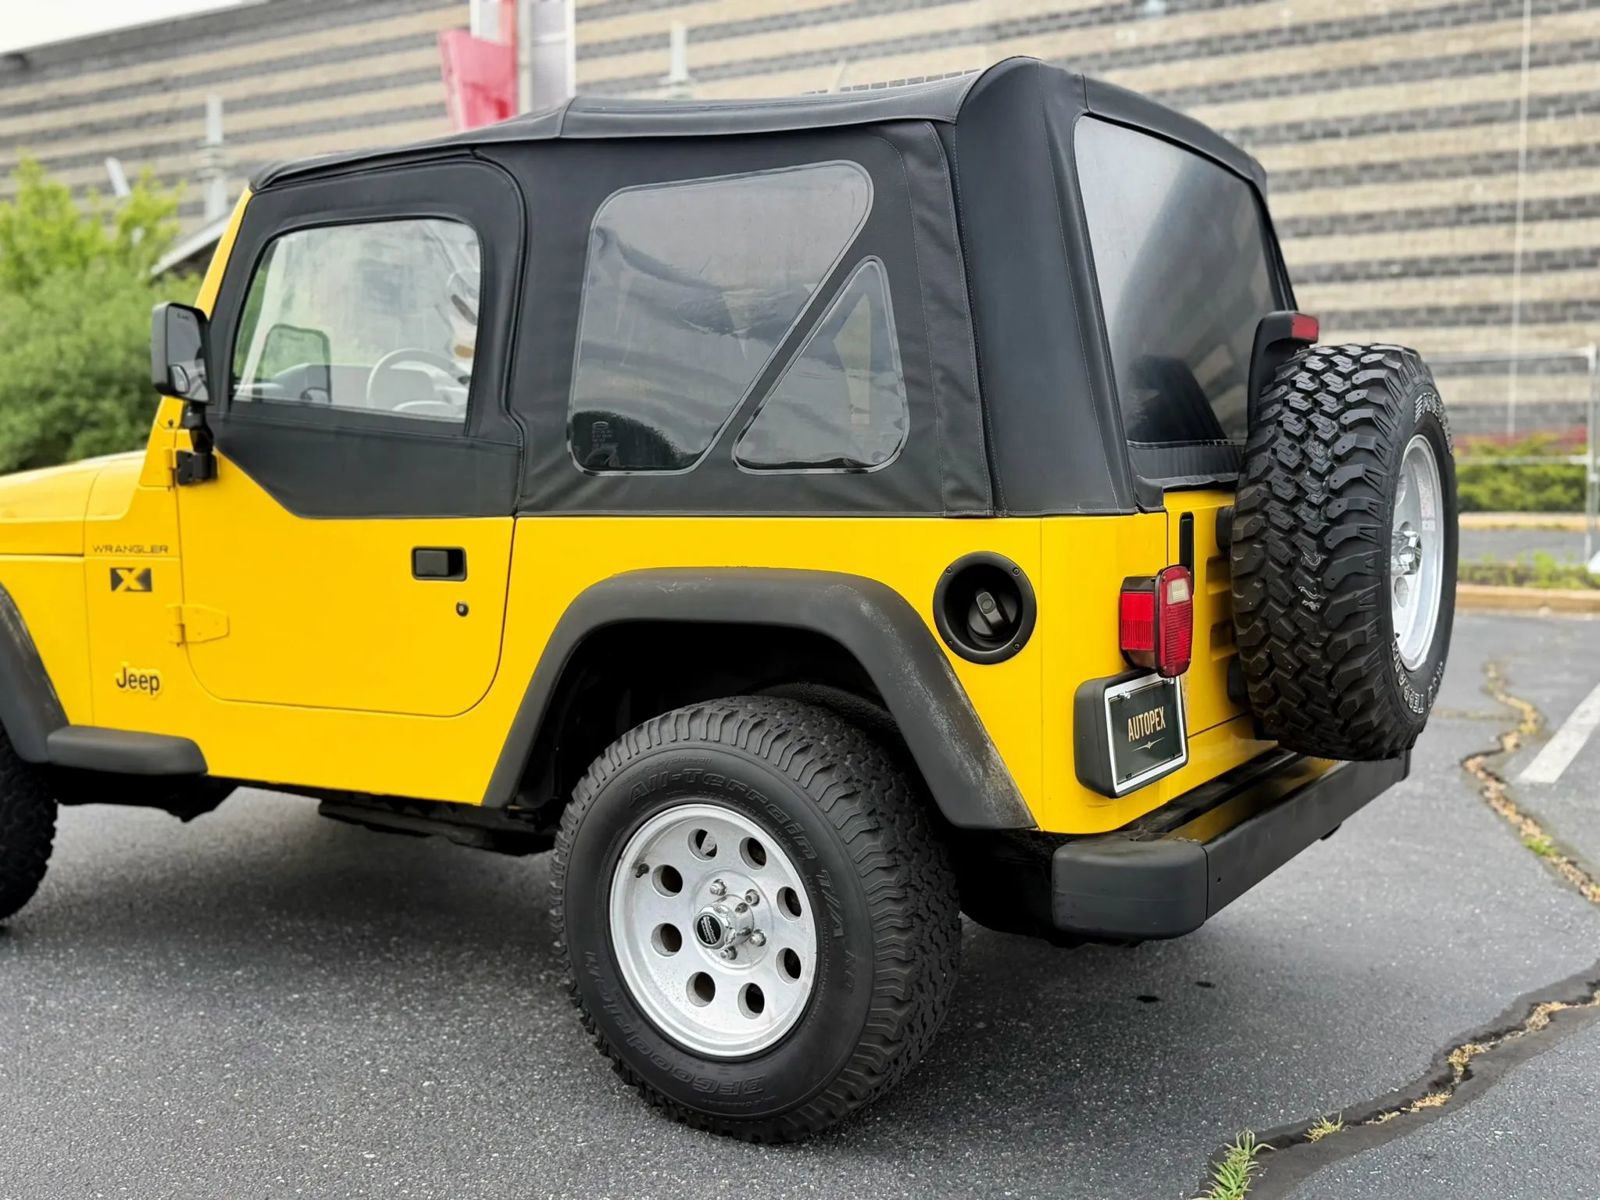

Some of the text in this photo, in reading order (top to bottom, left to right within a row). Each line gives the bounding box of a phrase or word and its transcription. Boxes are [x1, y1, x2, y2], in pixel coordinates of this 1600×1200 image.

[93, 544, 169, 554] WRANGLER
[115, 568, 147, 591] X
[116, 667, 160, 695] Jeep
[1127, 706, 1166, 742] AUTOPEX
